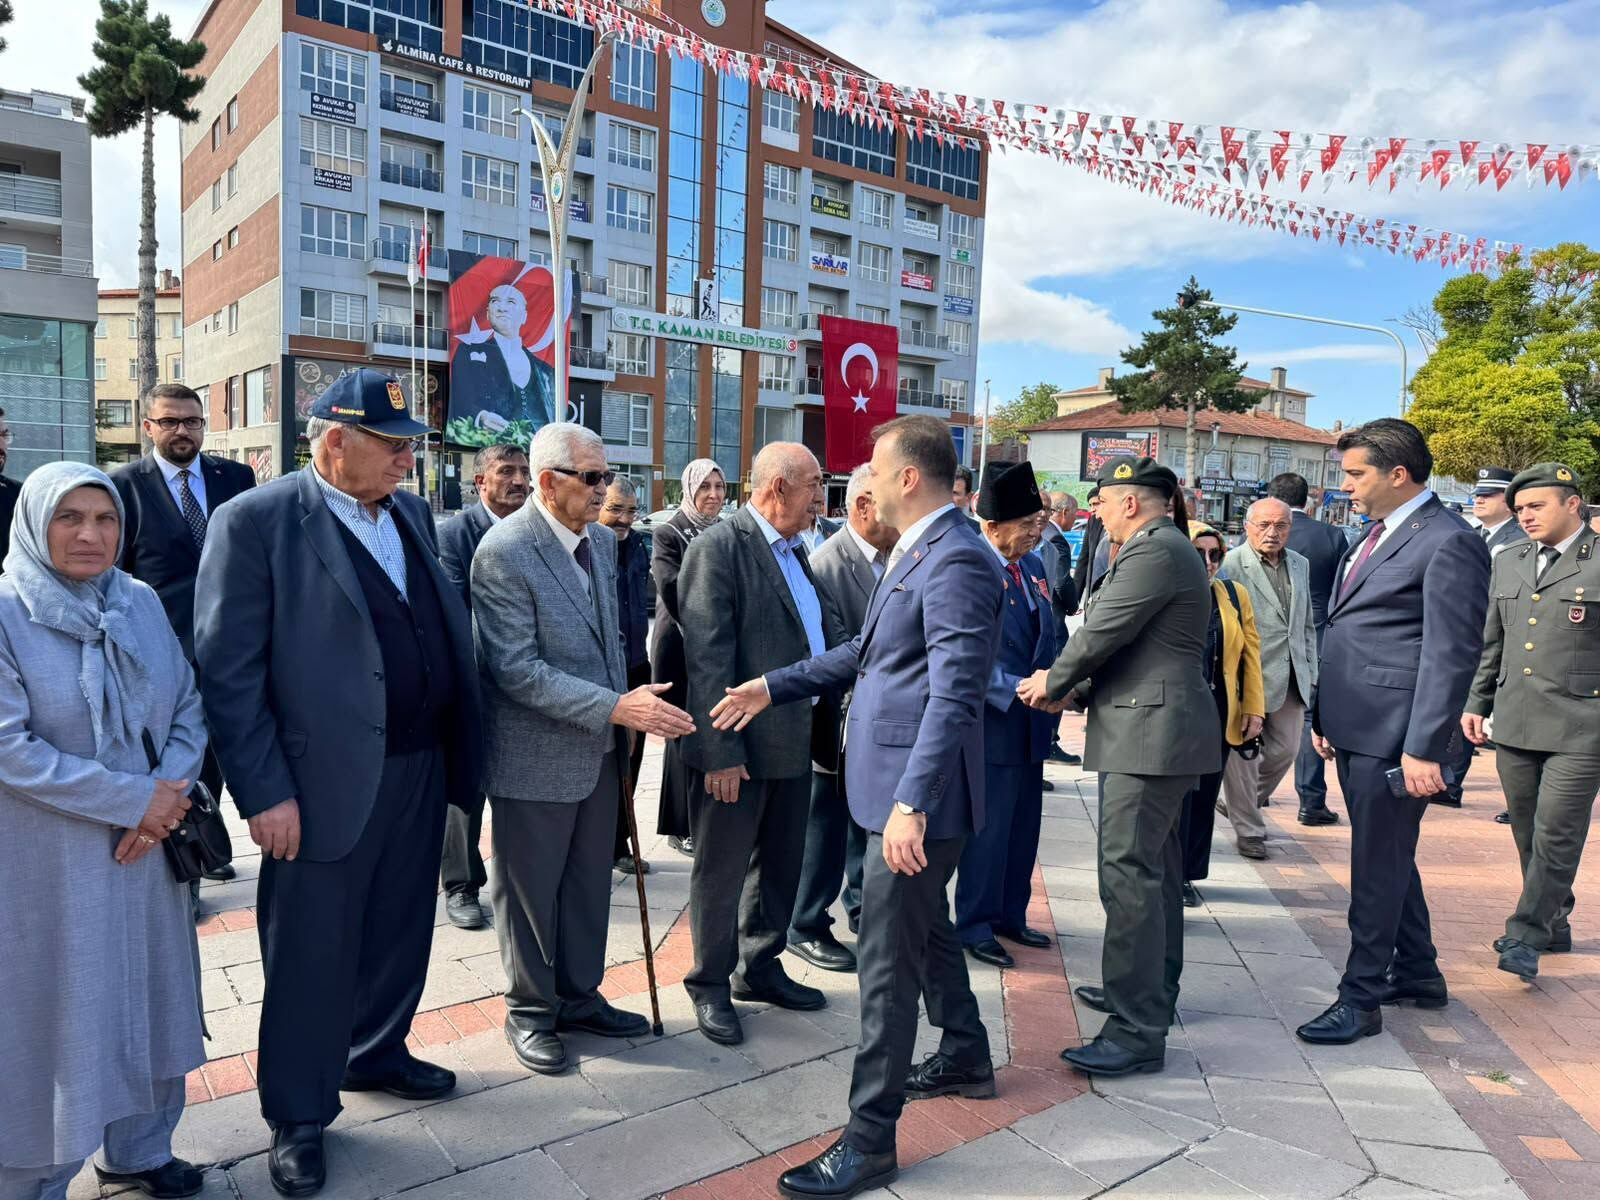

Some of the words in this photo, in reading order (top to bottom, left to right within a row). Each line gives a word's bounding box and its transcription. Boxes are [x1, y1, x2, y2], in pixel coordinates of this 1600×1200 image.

[396, 44, 436, 63] ALMİNA
[438, 55, 464, 70] CAFE
[465, 63, 473, 73] &
[475, 65, 531, 89] RESTORANT
[322, 97, 345, 107] AVUKAT
[403, 97, 430, 109] AVUKAT
[323, 171, 351, 181] AVUKAT
[811, 255, 849, 271] SARILAR
[629, 315, 655, 331] T.C.
[658, 320, 714, 340] KAMAN
[717, 329, 787, 350] BELEDİYESİ
